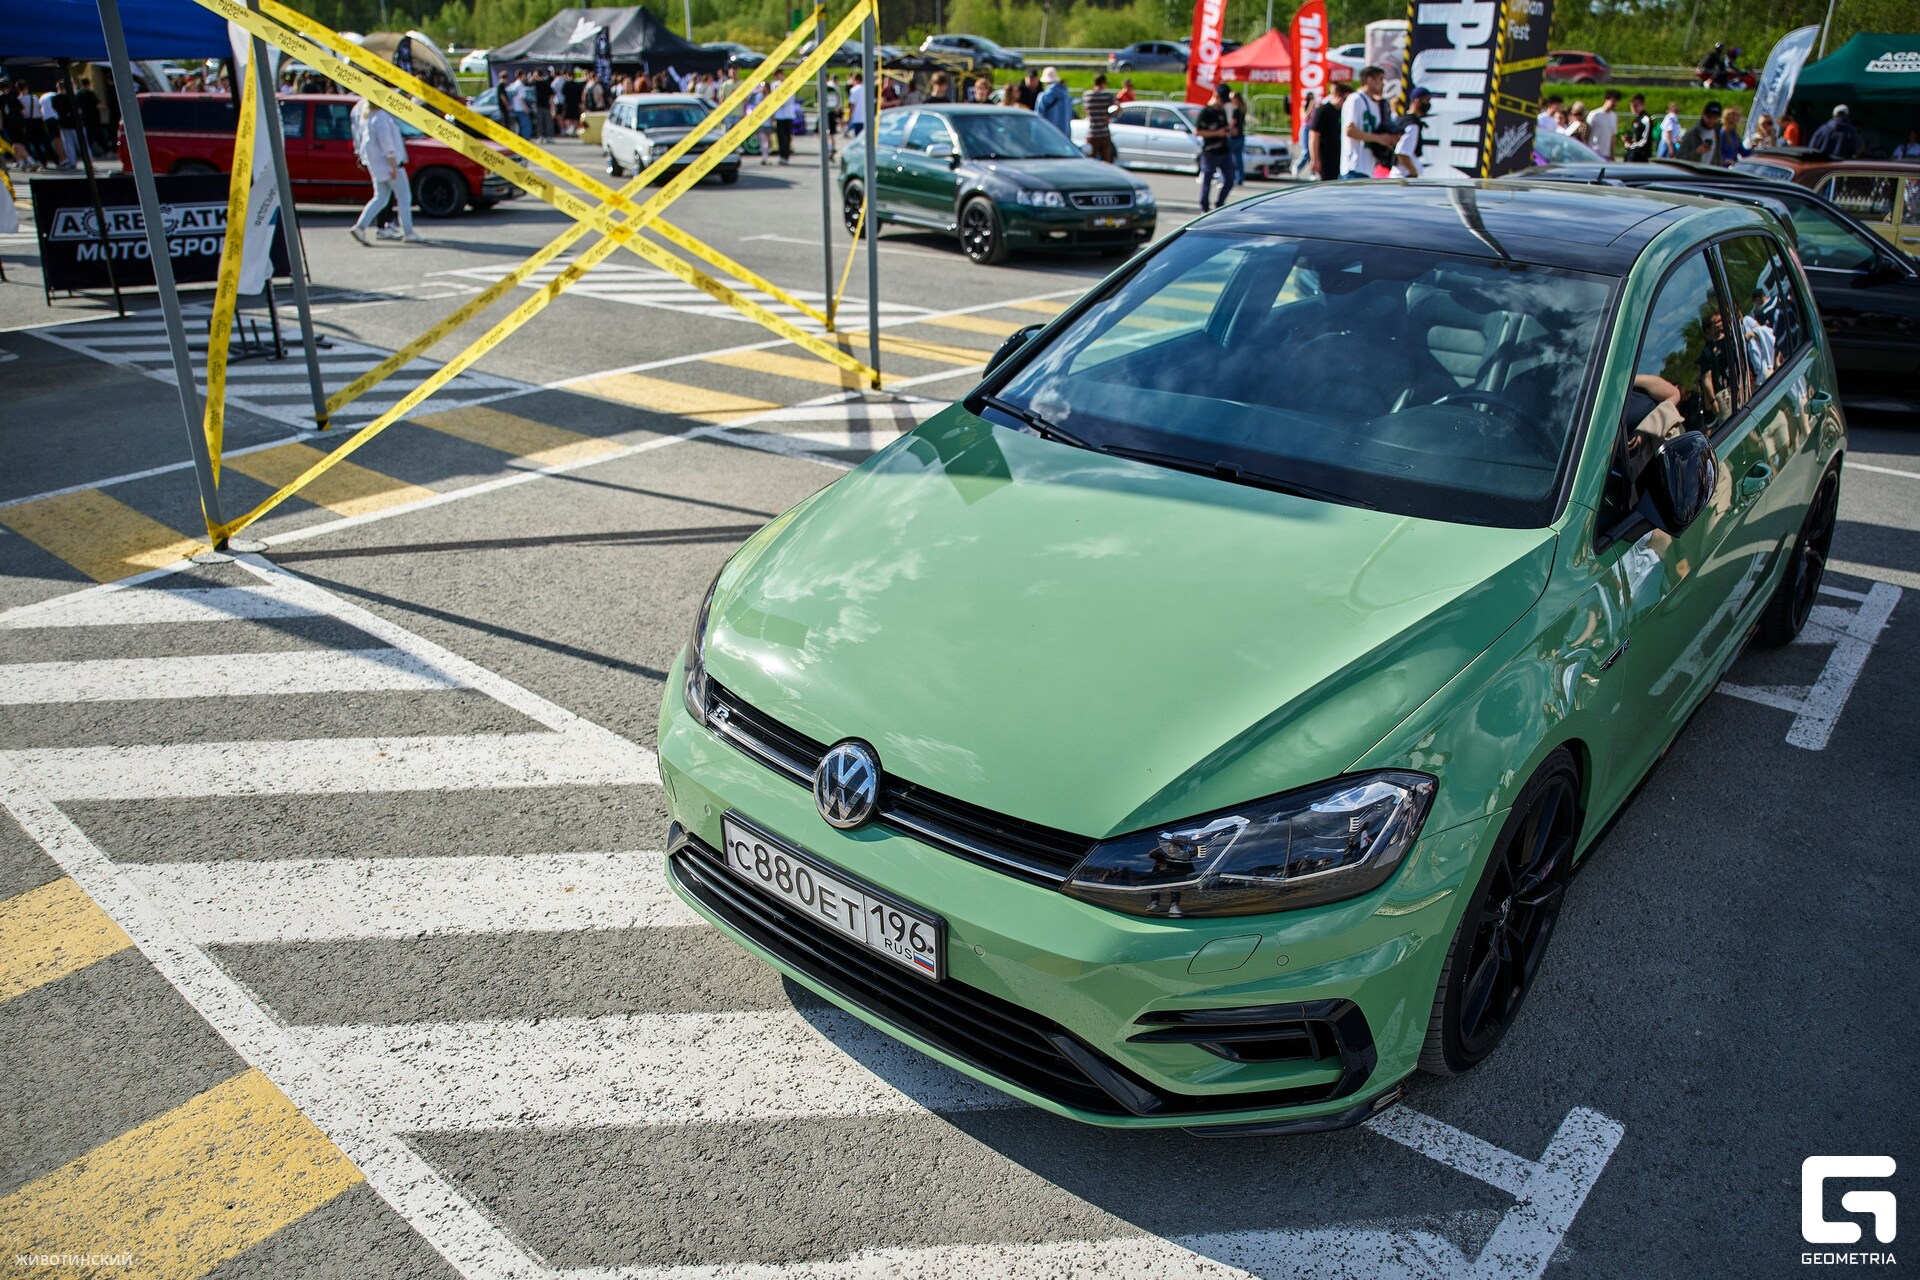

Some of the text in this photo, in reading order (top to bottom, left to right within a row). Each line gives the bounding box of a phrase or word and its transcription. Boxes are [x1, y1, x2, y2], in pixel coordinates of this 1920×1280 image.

[279, 32, 308, 51] Autolab
[280, 40, 298, 53] RCC
[1195, 0, 1222, 91] MOTU
[1879, 51, 1920, 61] AGR
[335, 64, 363, 83] Autolab
[336, 70, 352, 84] RCC
[387, 94, 413, 112] Autolab
[388, 102, 404, 113] RCC
[437, 123, 462, 141] Autolab
[871, 904, 927, 953] 196
[884, 938, 913, 960] RUS
